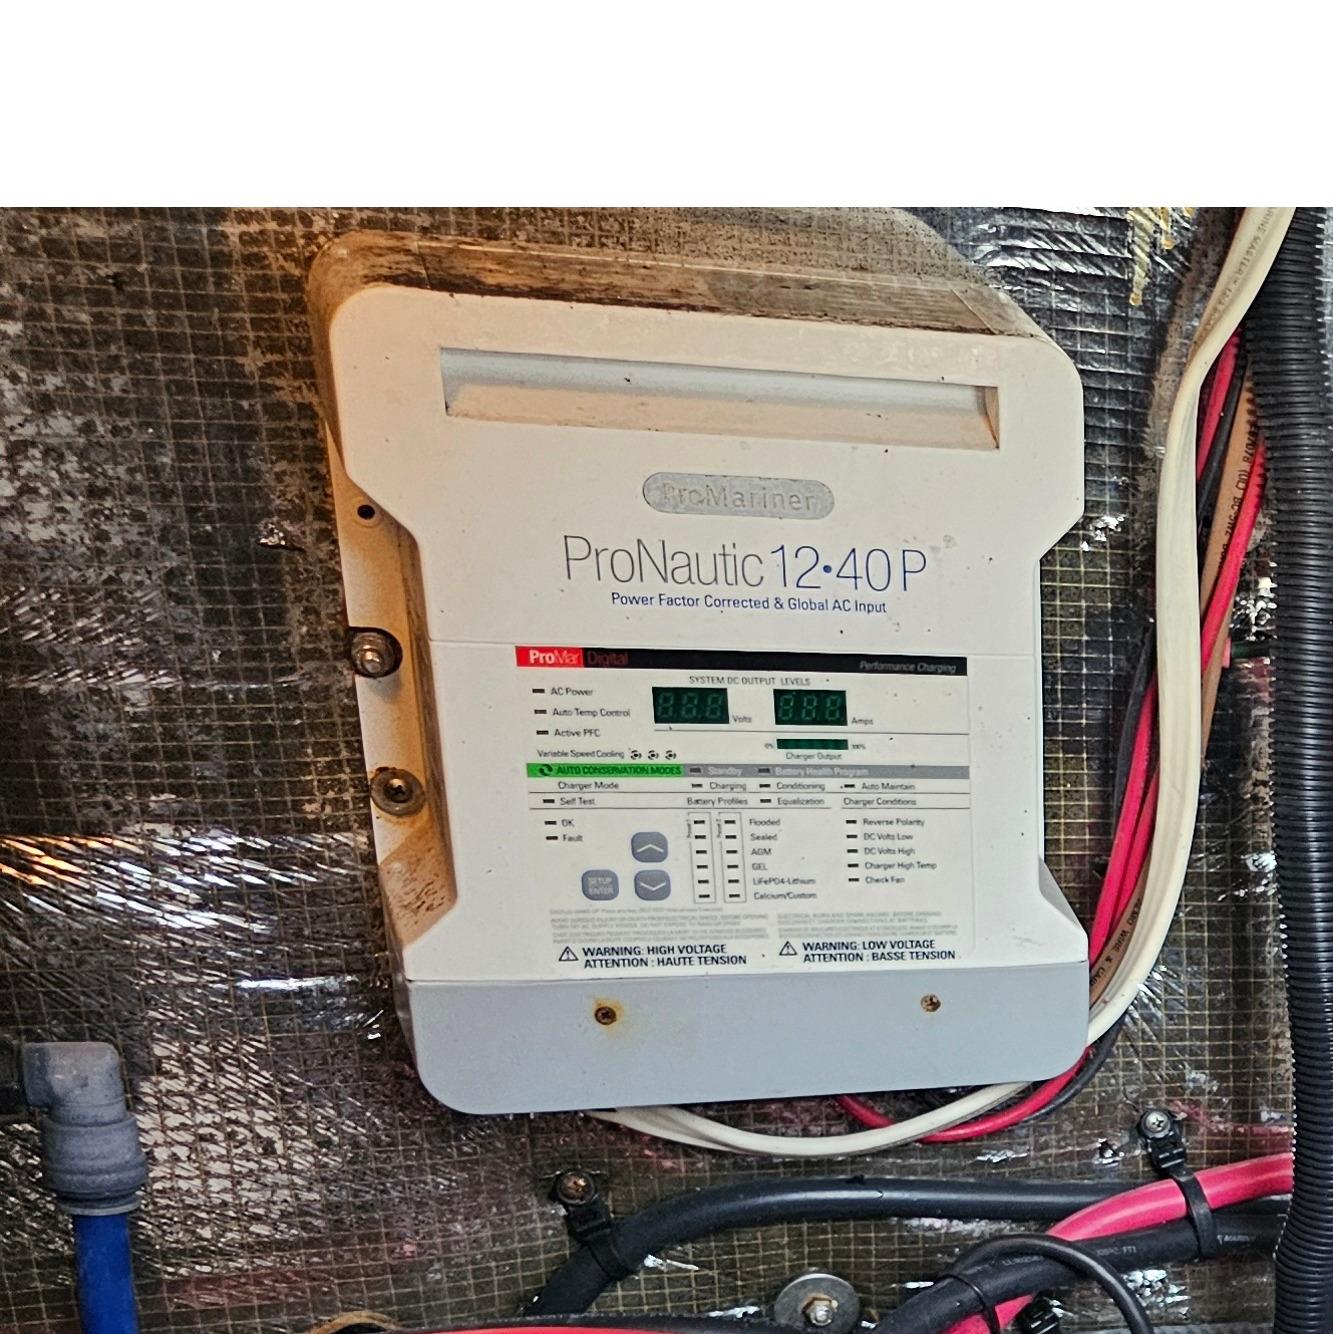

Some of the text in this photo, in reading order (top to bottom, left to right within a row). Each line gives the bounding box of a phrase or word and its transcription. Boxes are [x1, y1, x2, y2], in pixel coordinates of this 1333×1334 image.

[563, 534, 764, 588] ProNautic
[901, 548, 928, 592] P
[611, 592, 887, 614] Power Factor Corrected & Global AC Input
[689, 675, 811, 687] SYSTEM DC OUTPUT LEVELS
[550, 687, 593, 696] AC Power
[552, 708, 630, 718] Auto Temp Control
[554, 728, 582, 738] Active
[558, 781, 619, 790] Charger Mode
[582, 944, 727, 957] WARNING: HIGH VOLTAGE
[802, 939, 936, 951] WARNING: LOW VOLTAGE
[584, 955, 747, 969] ATTENTION HAUTE TENSION
[803, 950, 956, 963] ATTENTION BASSE TENSION
